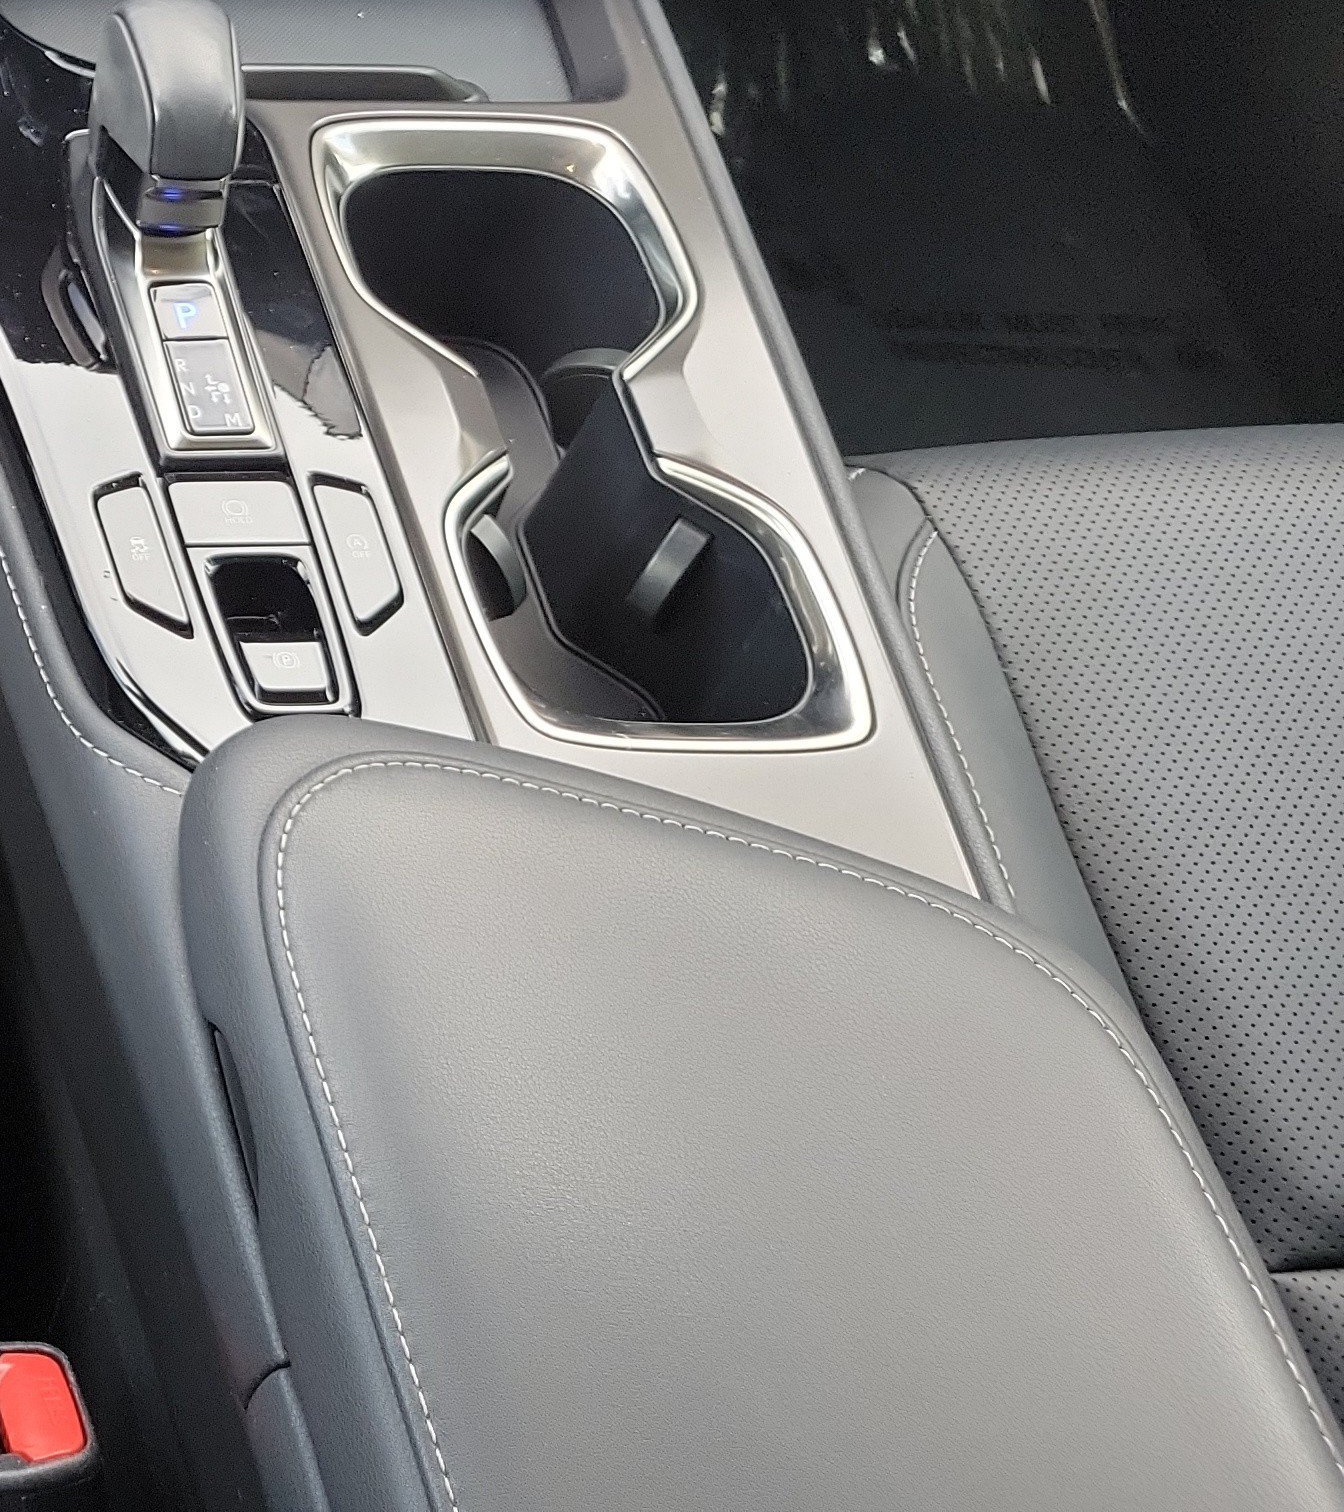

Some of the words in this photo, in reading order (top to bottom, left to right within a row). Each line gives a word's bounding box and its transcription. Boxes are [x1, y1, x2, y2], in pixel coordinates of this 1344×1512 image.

[175, 302, 197, 329] P
[175, 358, 189, 373] R
[181, 381, 196, 396] N
[188, 405, 202, 419] D
[224, 412, 243, 428] M
[224, 515, 254, 525] HOLD
[352, 549, 371, 559] OFF
